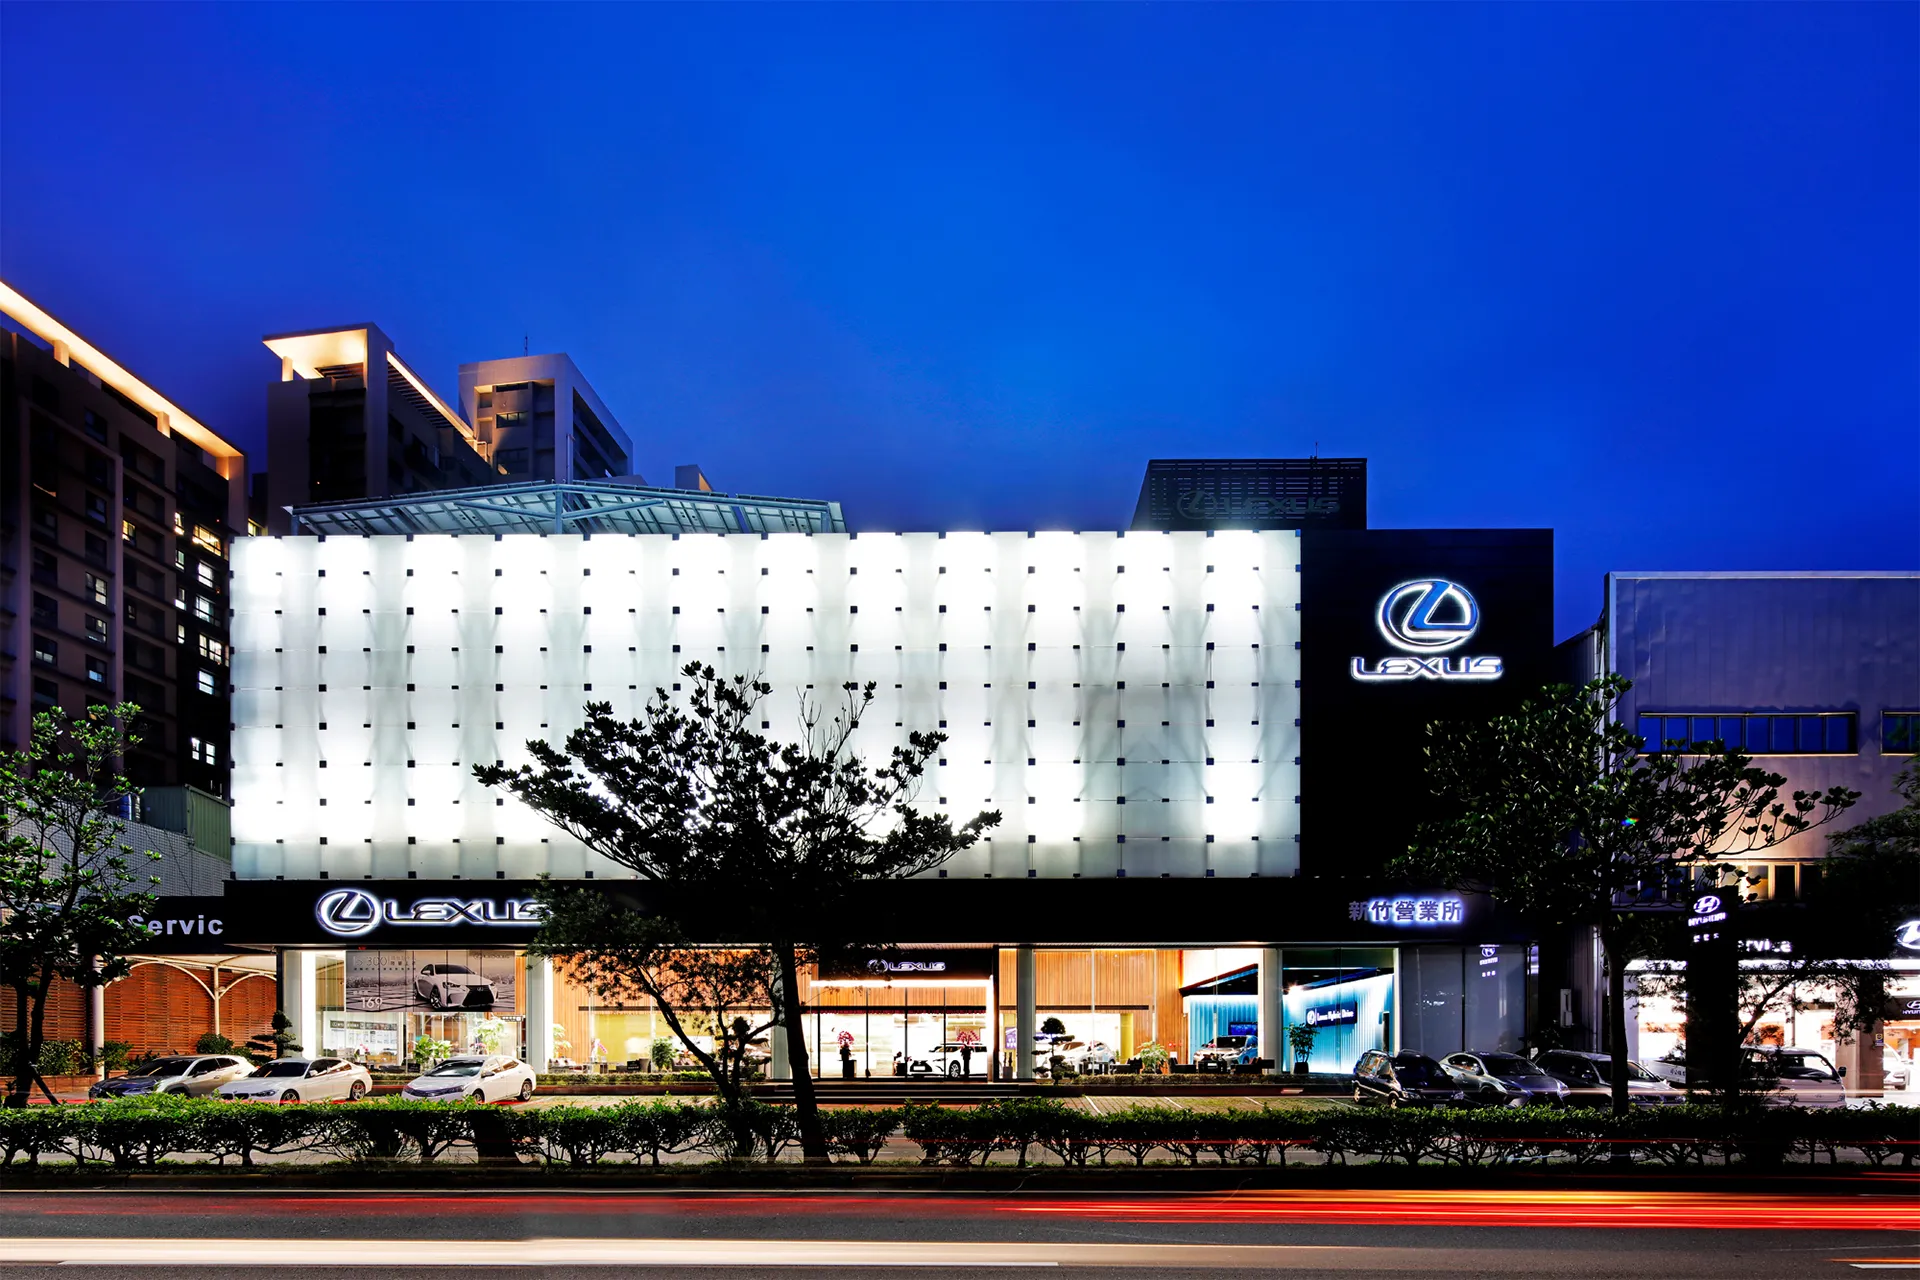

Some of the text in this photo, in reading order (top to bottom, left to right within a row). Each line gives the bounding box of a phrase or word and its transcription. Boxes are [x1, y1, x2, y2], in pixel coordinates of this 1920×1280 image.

[1224, 496, 1340, 513] LEXUS
[1351, 656, 1504, 681] LEXUS
[1348, 900, 1462, 921] 新竹營業所
[888, 962, 946, 972] LEXUS
[360, 996, 383, 1009] 169
